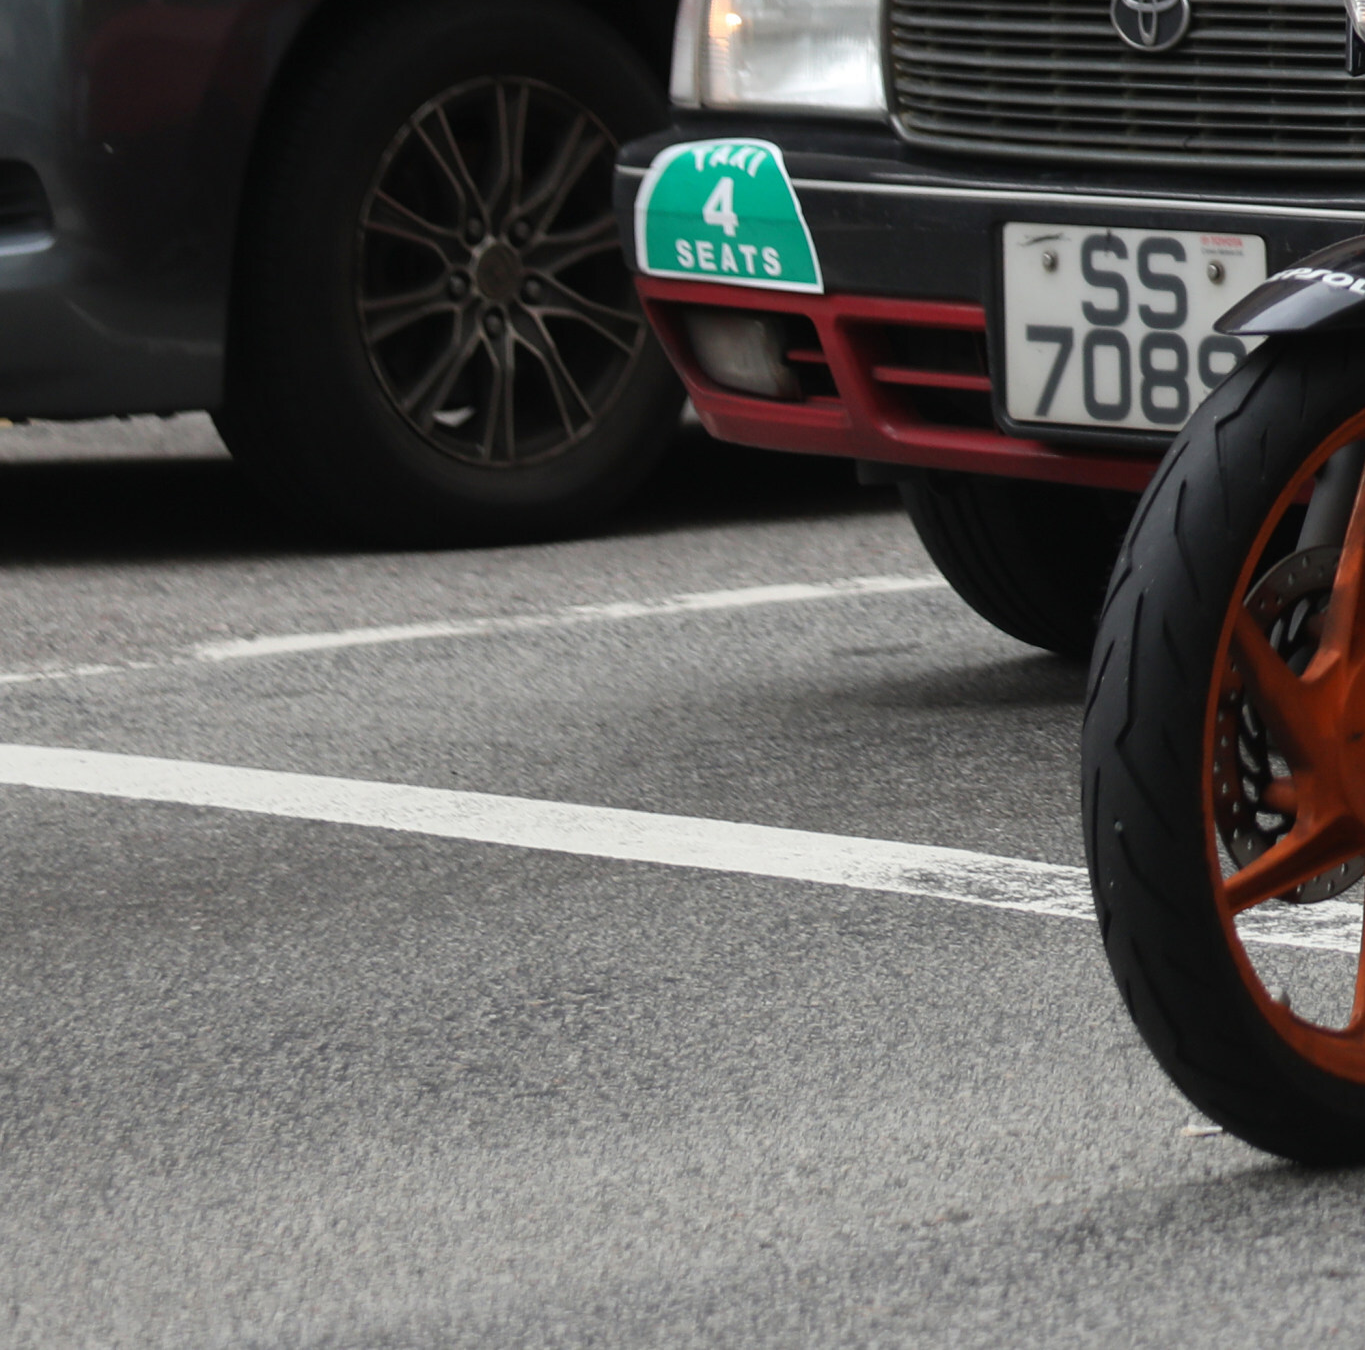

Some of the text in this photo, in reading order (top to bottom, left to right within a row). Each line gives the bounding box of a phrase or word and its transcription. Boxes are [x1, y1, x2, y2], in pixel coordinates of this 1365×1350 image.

[702, 176, 739, 237] 4
[675, 238, 783, 277] SEATS
[1080, 234, 1189, 330] SS
